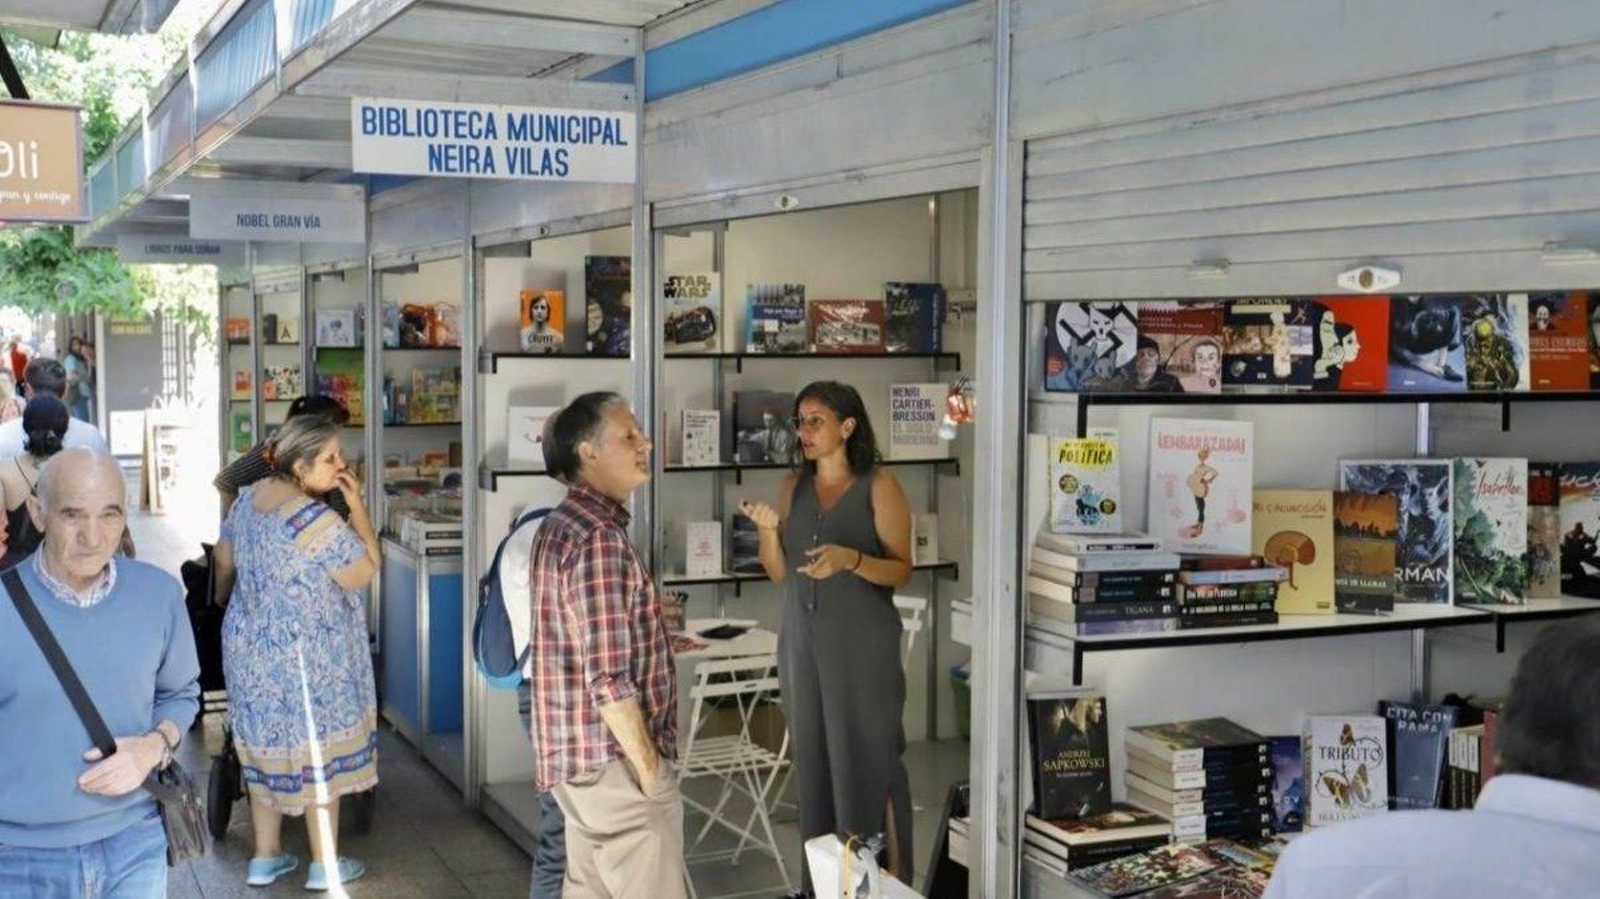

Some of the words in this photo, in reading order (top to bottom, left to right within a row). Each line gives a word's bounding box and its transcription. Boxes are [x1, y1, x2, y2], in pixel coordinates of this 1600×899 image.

[362, 106, 497, 140] BIBLIOTECA
[507, 112, 628, 146] MUNICIPAL
[428, 144, 496, 174] NEIRA
[505, 146, 569, 177] VILAS
[236, 213, 269, 228] NOBEL
[272, 214, 301, 229] GRAN
[303, 213, 320, 229] VÍA
[664, 275, 711, 286] STAR
[664, 286, 711, 298] WARS
[892, 387, 920, 397] HENRI
[892, 398, 935, 409] CARTIER-
[892, 410, 935, 421] BRESSON
[1387, 706, 1417, 720] CITA
[1422, 710, 1452, 724] CON
[1397, 720, 1438, 733] RAMA
[1319, 745, 1381, 761] TRIBUTO
[1043, 758, 1105, 772] SAPKOWSKI
